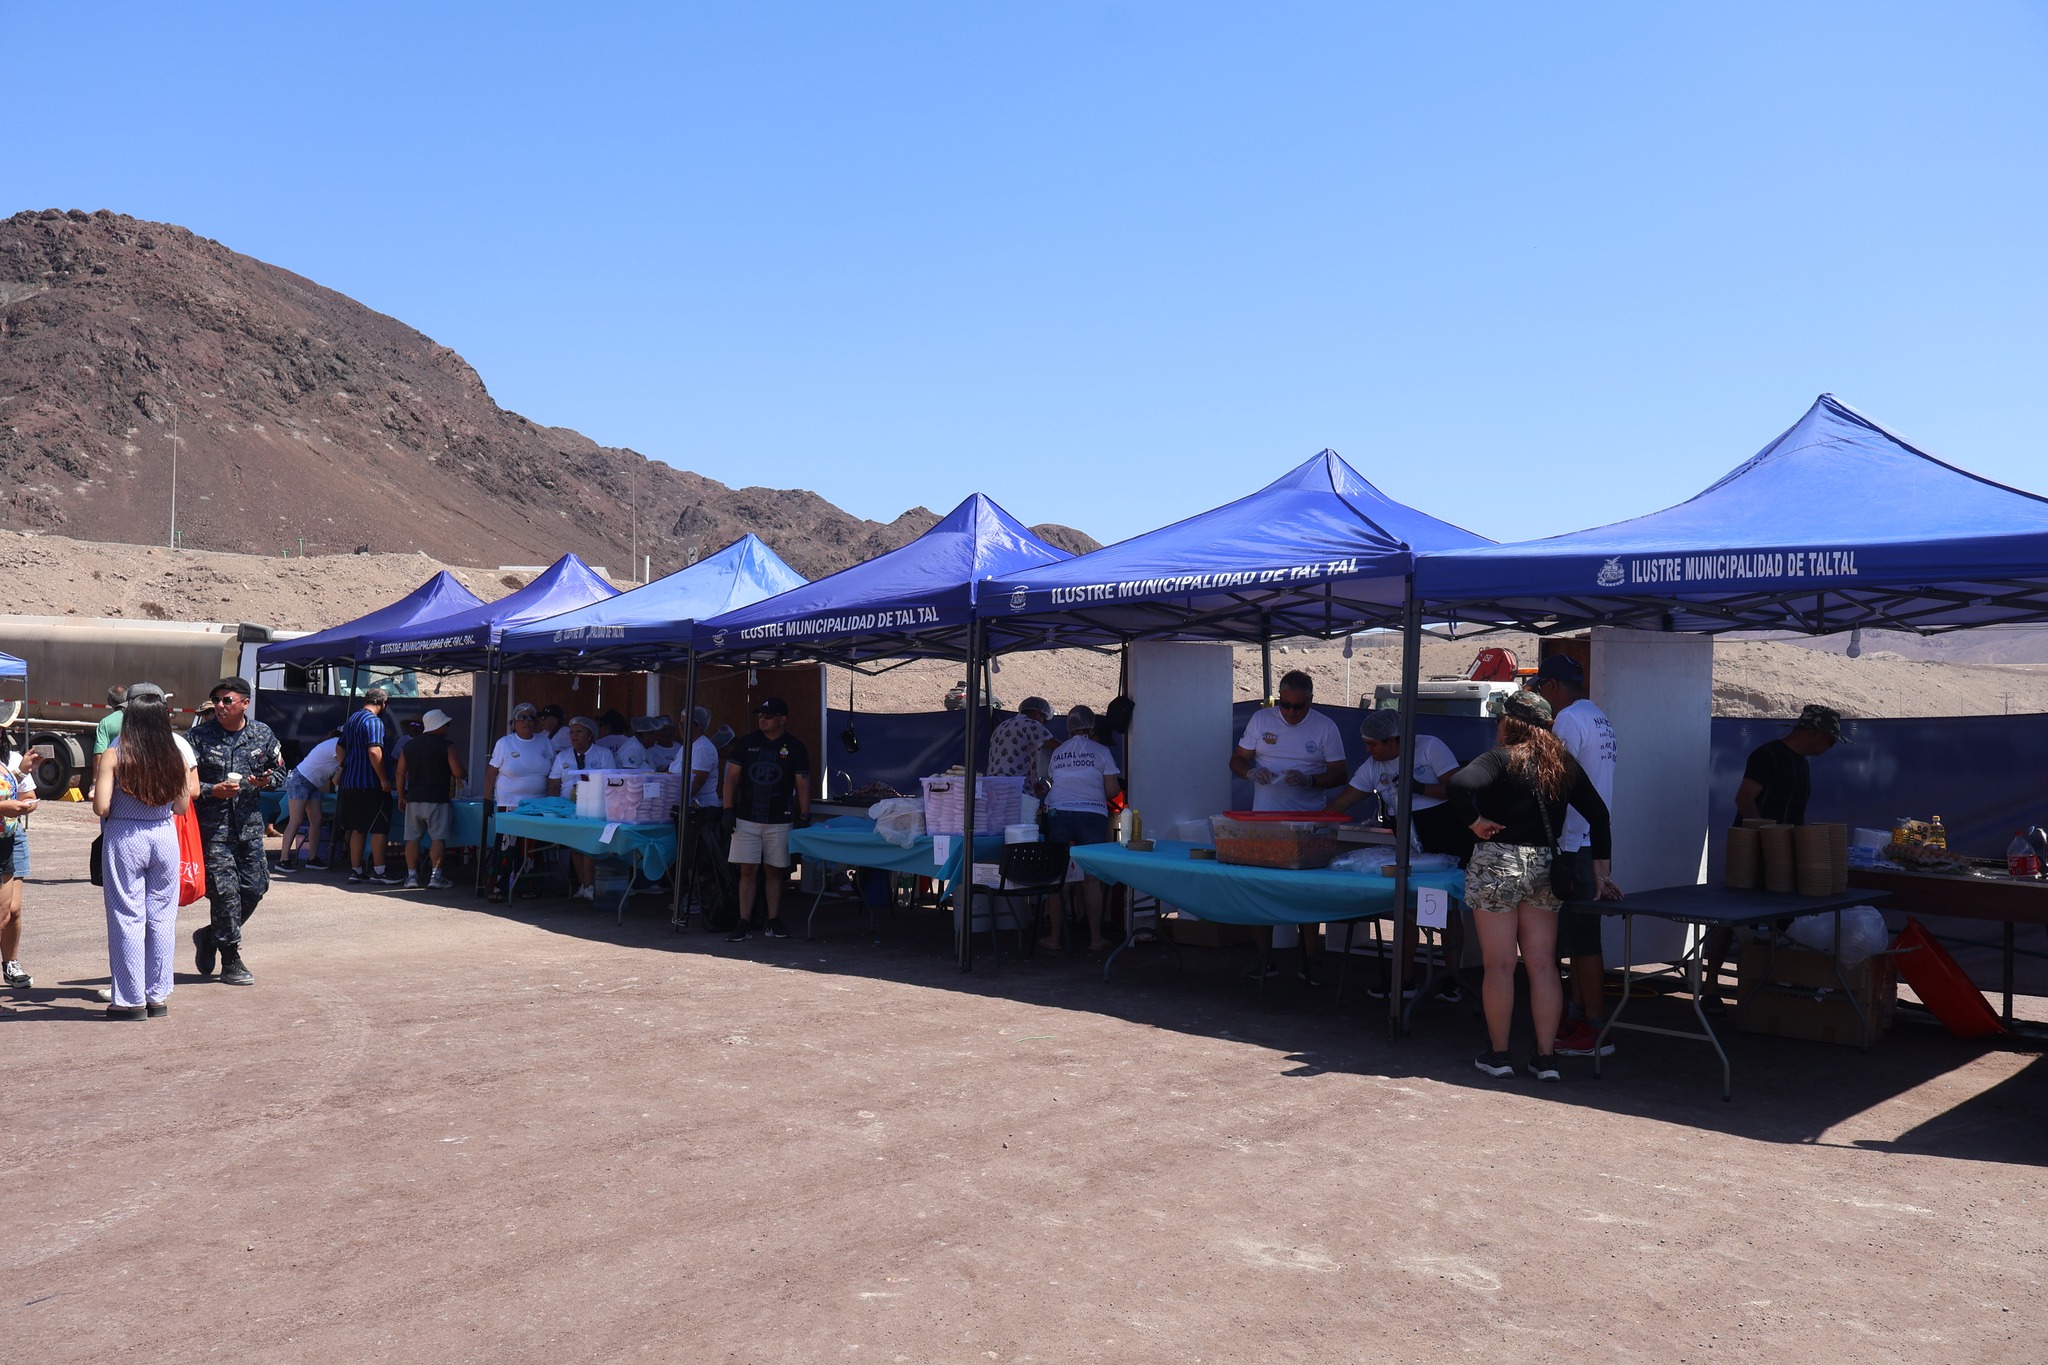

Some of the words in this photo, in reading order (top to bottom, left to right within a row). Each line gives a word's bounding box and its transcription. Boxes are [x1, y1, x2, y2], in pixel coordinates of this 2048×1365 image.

[1051, 583, 1115, 604] ILUSTRE
[1118, 570, 1256, 598] MUNICIPALIDAD
[1259, 568, 1288, 583] DE
[1327, 558, 1360, 575] TAL
[1631, 557, 1682, 583] ILUSTRE
[1685, 553, 1783, 580] MUNICIPALIDAD
[1787, 552, 1804, 577] DE
[741, 623, 784, 640] ILUSTRE
[786, 614, 876, 637] MUNICIPALIDAD
[878, 611, 894, 628] DE
[895, 608, 916, 626] TAL
[917, 606, 940, 623] TAL
[1425, 893, 1437, 916] 5
